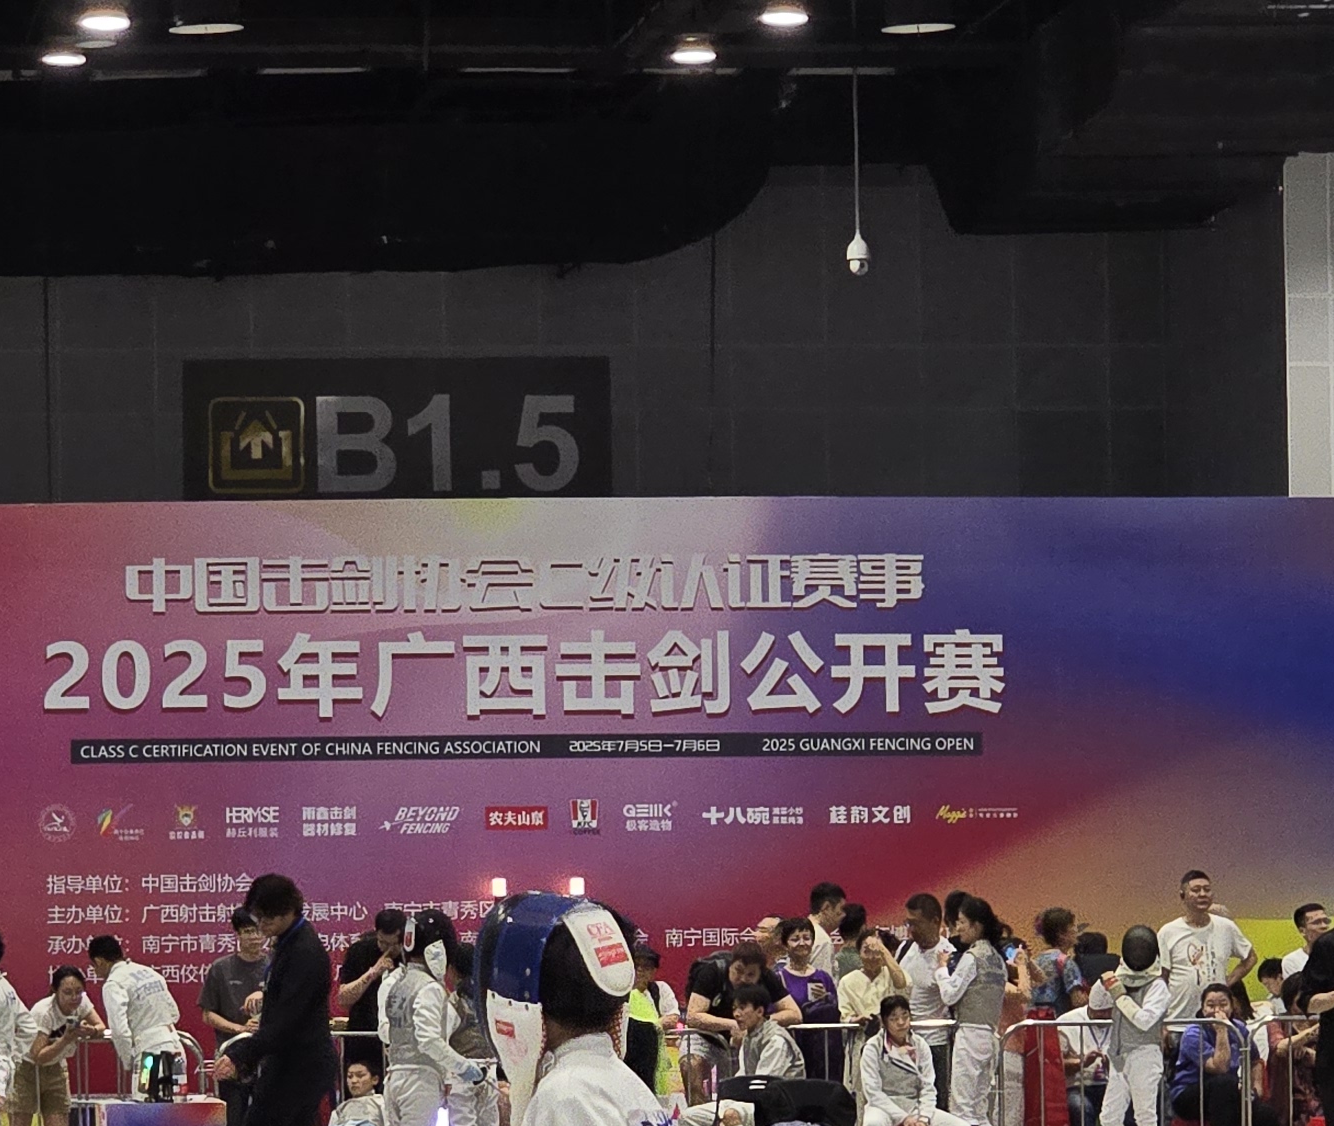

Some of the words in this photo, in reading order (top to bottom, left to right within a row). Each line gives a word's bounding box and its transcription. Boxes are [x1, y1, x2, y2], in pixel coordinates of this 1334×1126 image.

[316, 394, 579, 492] B1.5
[44, 629, 1006, 719] 2025年广西击剑公开赛
[80, 745, 125, 759] CLASS
[128, 745, 139, 758] C
[142, 743, 248, 758] CERTIFICATION
[252, 743, 297, 757] EVENT
[301, 743, 321, 756] OF
[325, 742, 372, 756] CHINA
[376, 741, 440, 755] FENCING
[443, 741, 542, 755] ASSOCIATION
[762, 738, 796, 752] 2025
[799, 738, 866, 752] GUANGXI
[869, 738, 932, 751] FENCING
[935, 737, 974, 751] OPEN
[395, 806, 460, 822] BEYOND
[489, 810, 544, 826] 农夫山泉
[702, 807, 770, 825] 十八碗
[829, 805, 911, 824] 桂韵文创
[302, 823, 357, 836] 器材修复
[400, 823, 451, 834] FENCING
[47, 874, 131, 894] 指导单位：
[142, 872, 253, 893] 中国击剑协会
[47, 904, 131, 924] 主办单位：
[142, 903, 239, 923] 广西射击射
